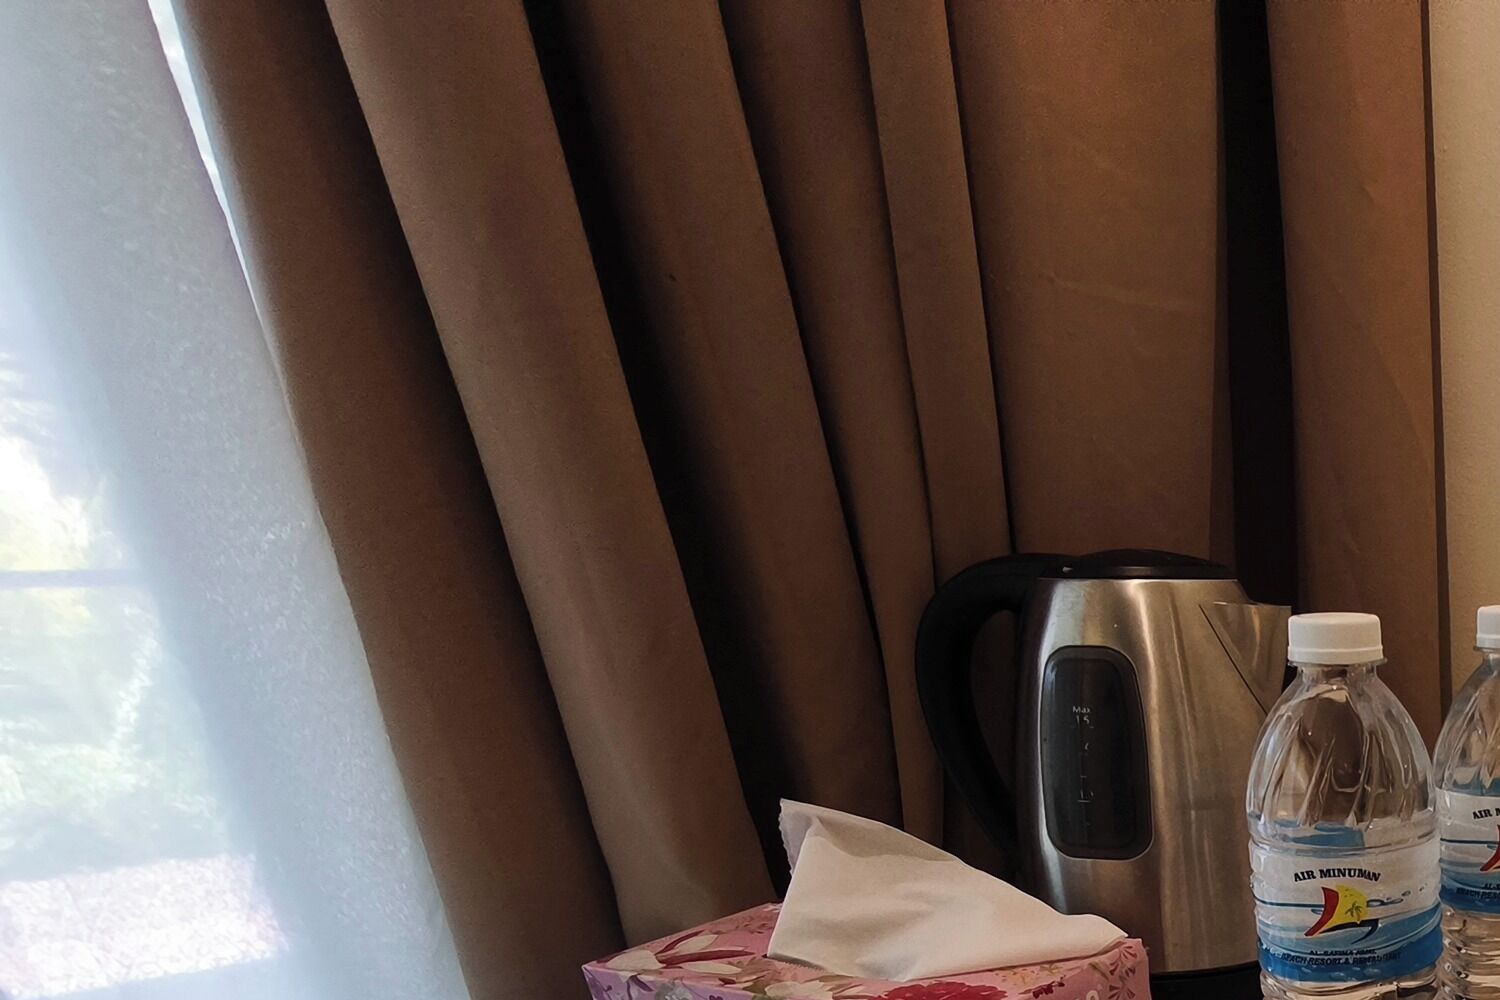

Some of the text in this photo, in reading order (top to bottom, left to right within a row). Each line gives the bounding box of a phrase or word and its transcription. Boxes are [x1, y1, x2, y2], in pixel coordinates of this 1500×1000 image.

[1472, 809, 1493, 820] AIR
[1294, 867, 1382, 882] AIR MINUMAN
[1307, 957, 1341, 965] RESORT
